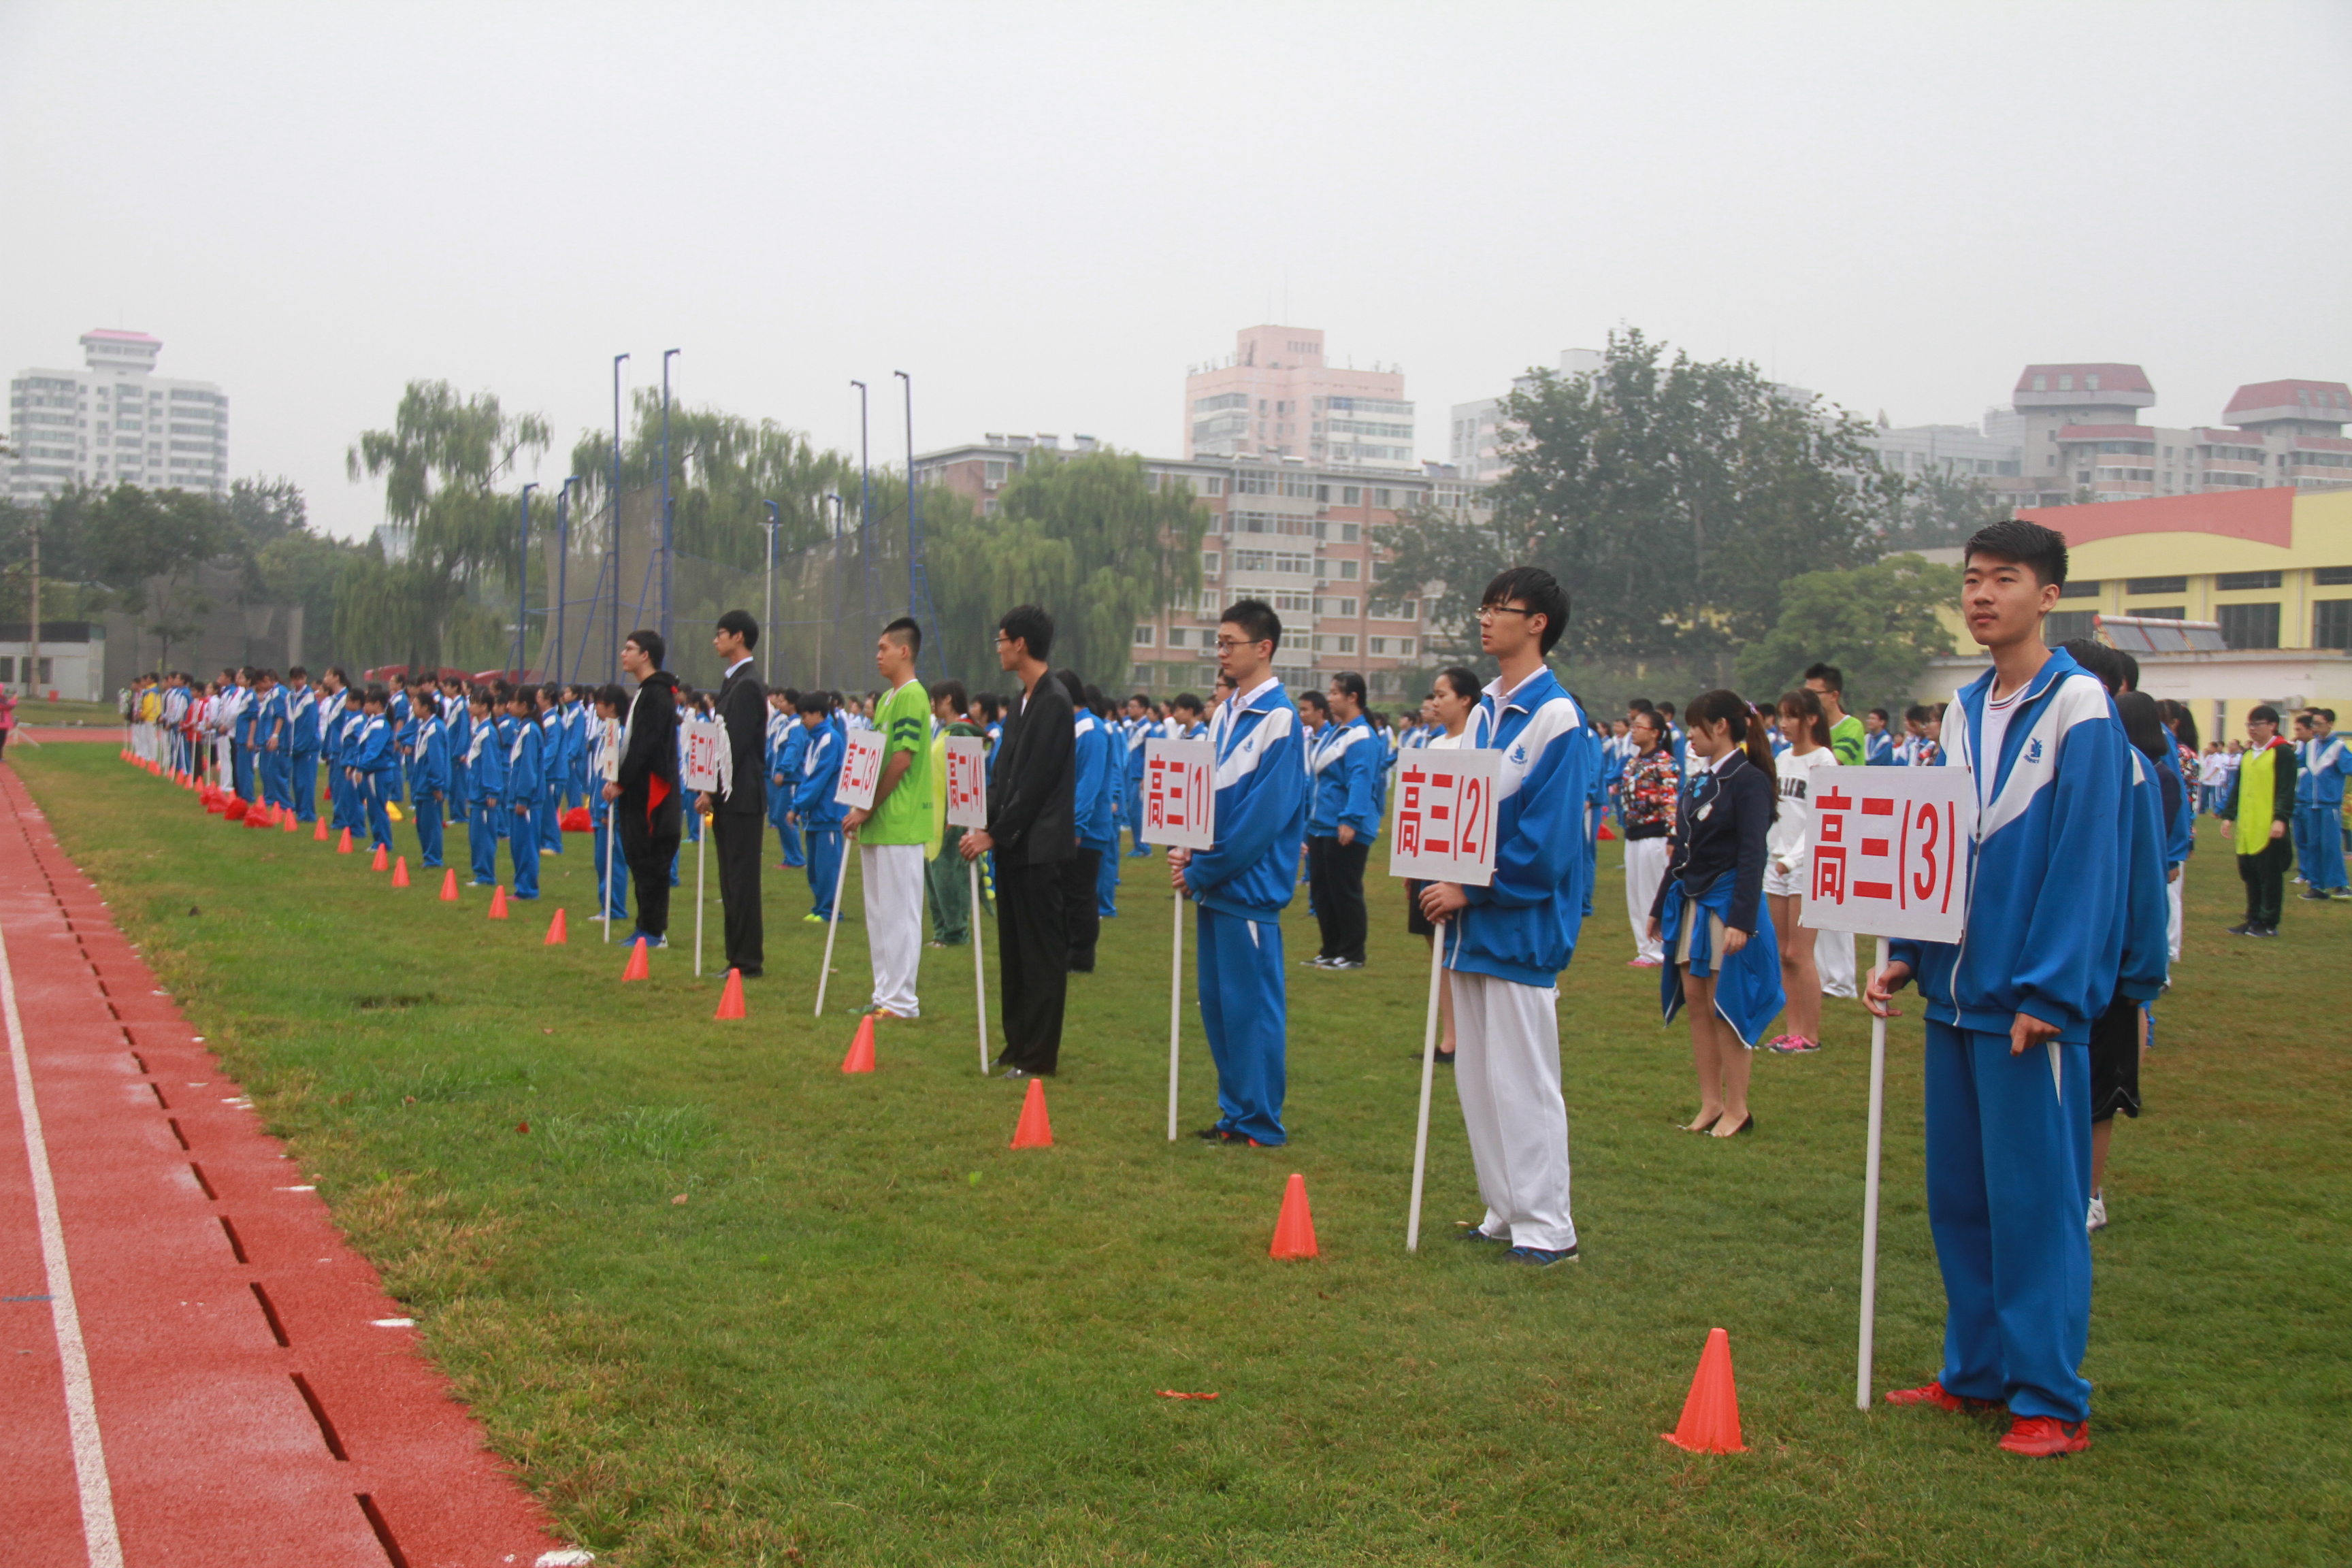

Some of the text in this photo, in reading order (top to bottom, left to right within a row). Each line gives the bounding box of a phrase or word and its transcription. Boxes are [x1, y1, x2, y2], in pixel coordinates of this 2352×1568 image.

[690, 730, 715, 779] 高二(2)
[841, 739, 881, 797] 高二(3)
[948, 747, 983, 813] 高二(4)
[1148, 754, 1210, 834] 高三(1)
[1397, 764, 1490, 864] 高三(2)
[1812, 785, 1955, 914] 高三(3)
